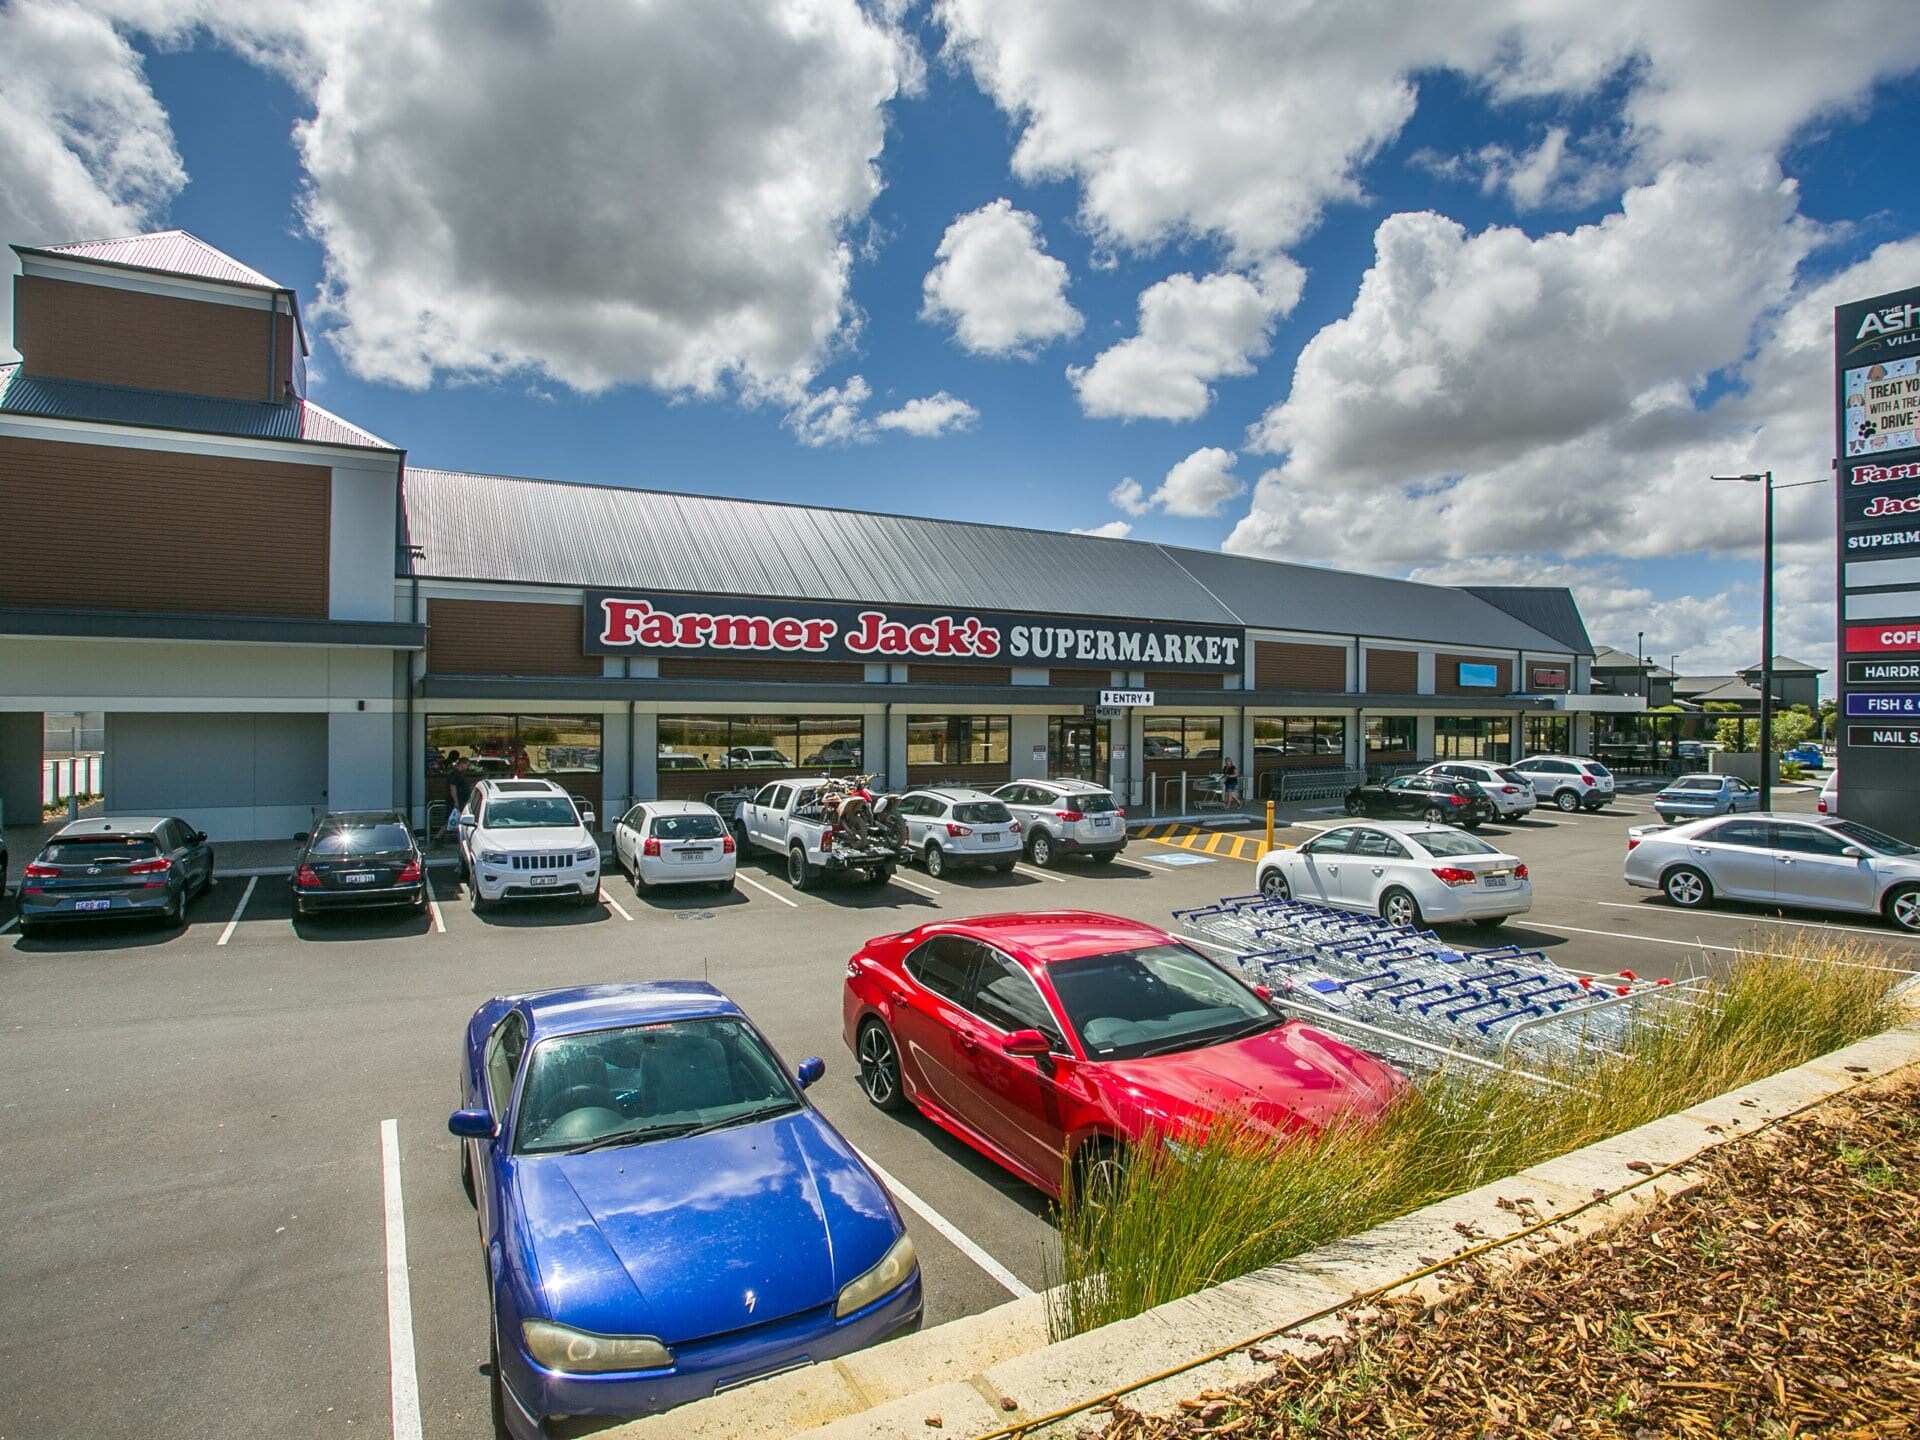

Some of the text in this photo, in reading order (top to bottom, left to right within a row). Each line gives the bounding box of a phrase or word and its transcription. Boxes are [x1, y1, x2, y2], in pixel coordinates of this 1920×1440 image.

[1879, 305, 1902, 316] THE
[1869, 381, 1903, 400] TREAT
[1870, 396, 1920, 414] WITH A TRE
[1881, 410, 1920, 430] DRIVE-
[1864, 494, 1920, 516] Jac
[601, 598, 1239, 665] Farmer Jack's SUPERMARKET
[1881, 630, 1920, 645] COF
[1865, 665, 1920, 678] HAIRDR
[1113, 693, 1142, 703] ENTRY
[1868, 699, 1900, 710] FISH
[1903, 699, 1914, 711] &
[1103, 707, 1121, 716] ENTRY
[1873, 731, 1920, 743] NAIL S
